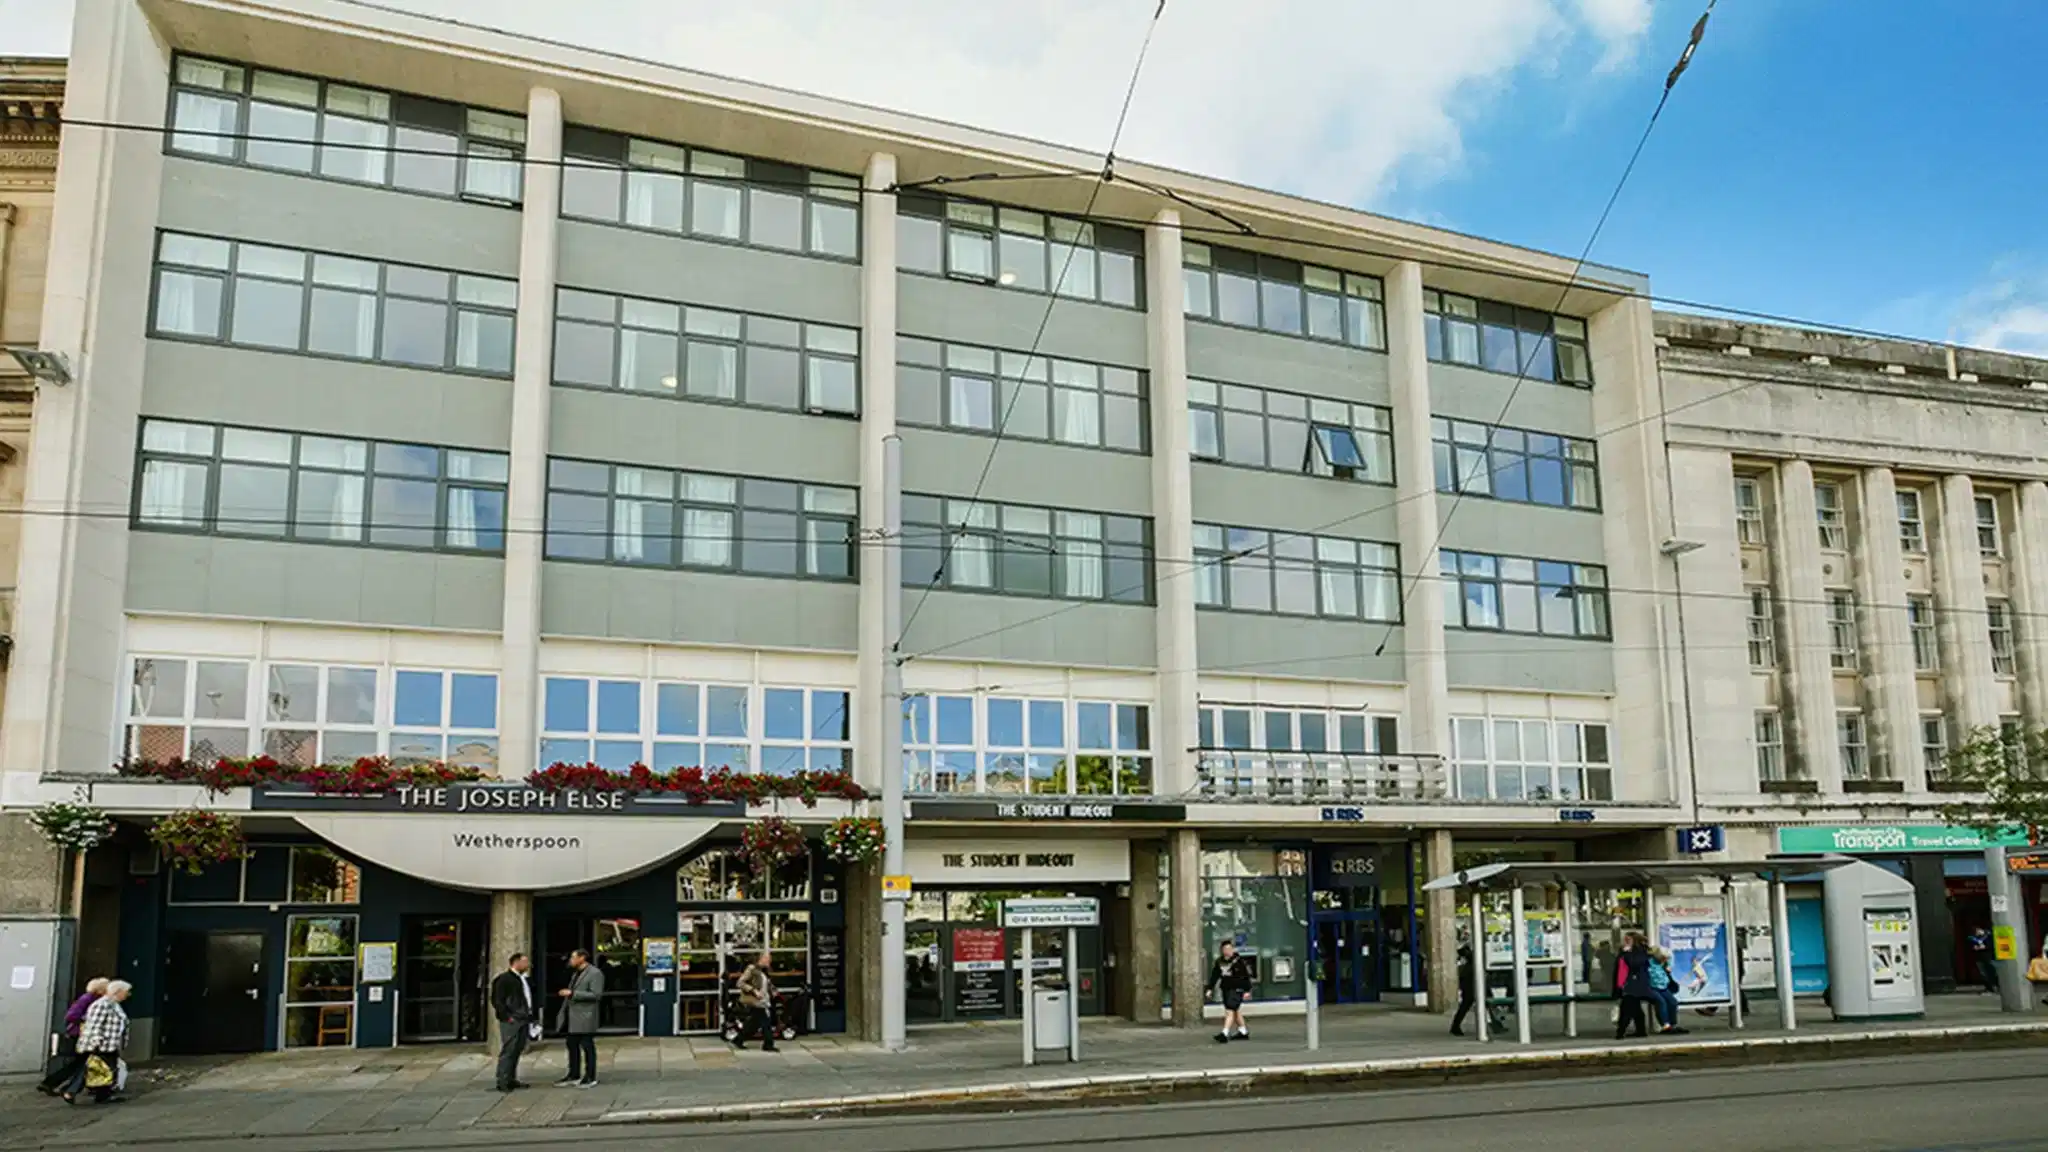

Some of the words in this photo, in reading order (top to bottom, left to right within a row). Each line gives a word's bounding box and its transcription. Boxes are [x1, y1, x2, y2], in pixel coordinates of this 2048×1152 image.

[396, 787, 447, 806] THE
[457, 788, 556, 811] JOSEPH
[567, 790, 624, 809] ELSE
[996, 804, 1016, 817] THE
[1021, 804, 1065, 817] STUDENT
[1069, 804, 1114, 817] HIDEOUT
[453, 833, 581, 851] Wetherspoon
[1832, 831, 1906, 850] Transport
[942, 854, 965, 868] THE
[970, 854, 1020, 868] STUDENT
[1026, 854, 1075, 868] HIDEOUT
[1346, 858, 1375, 874] RBS
